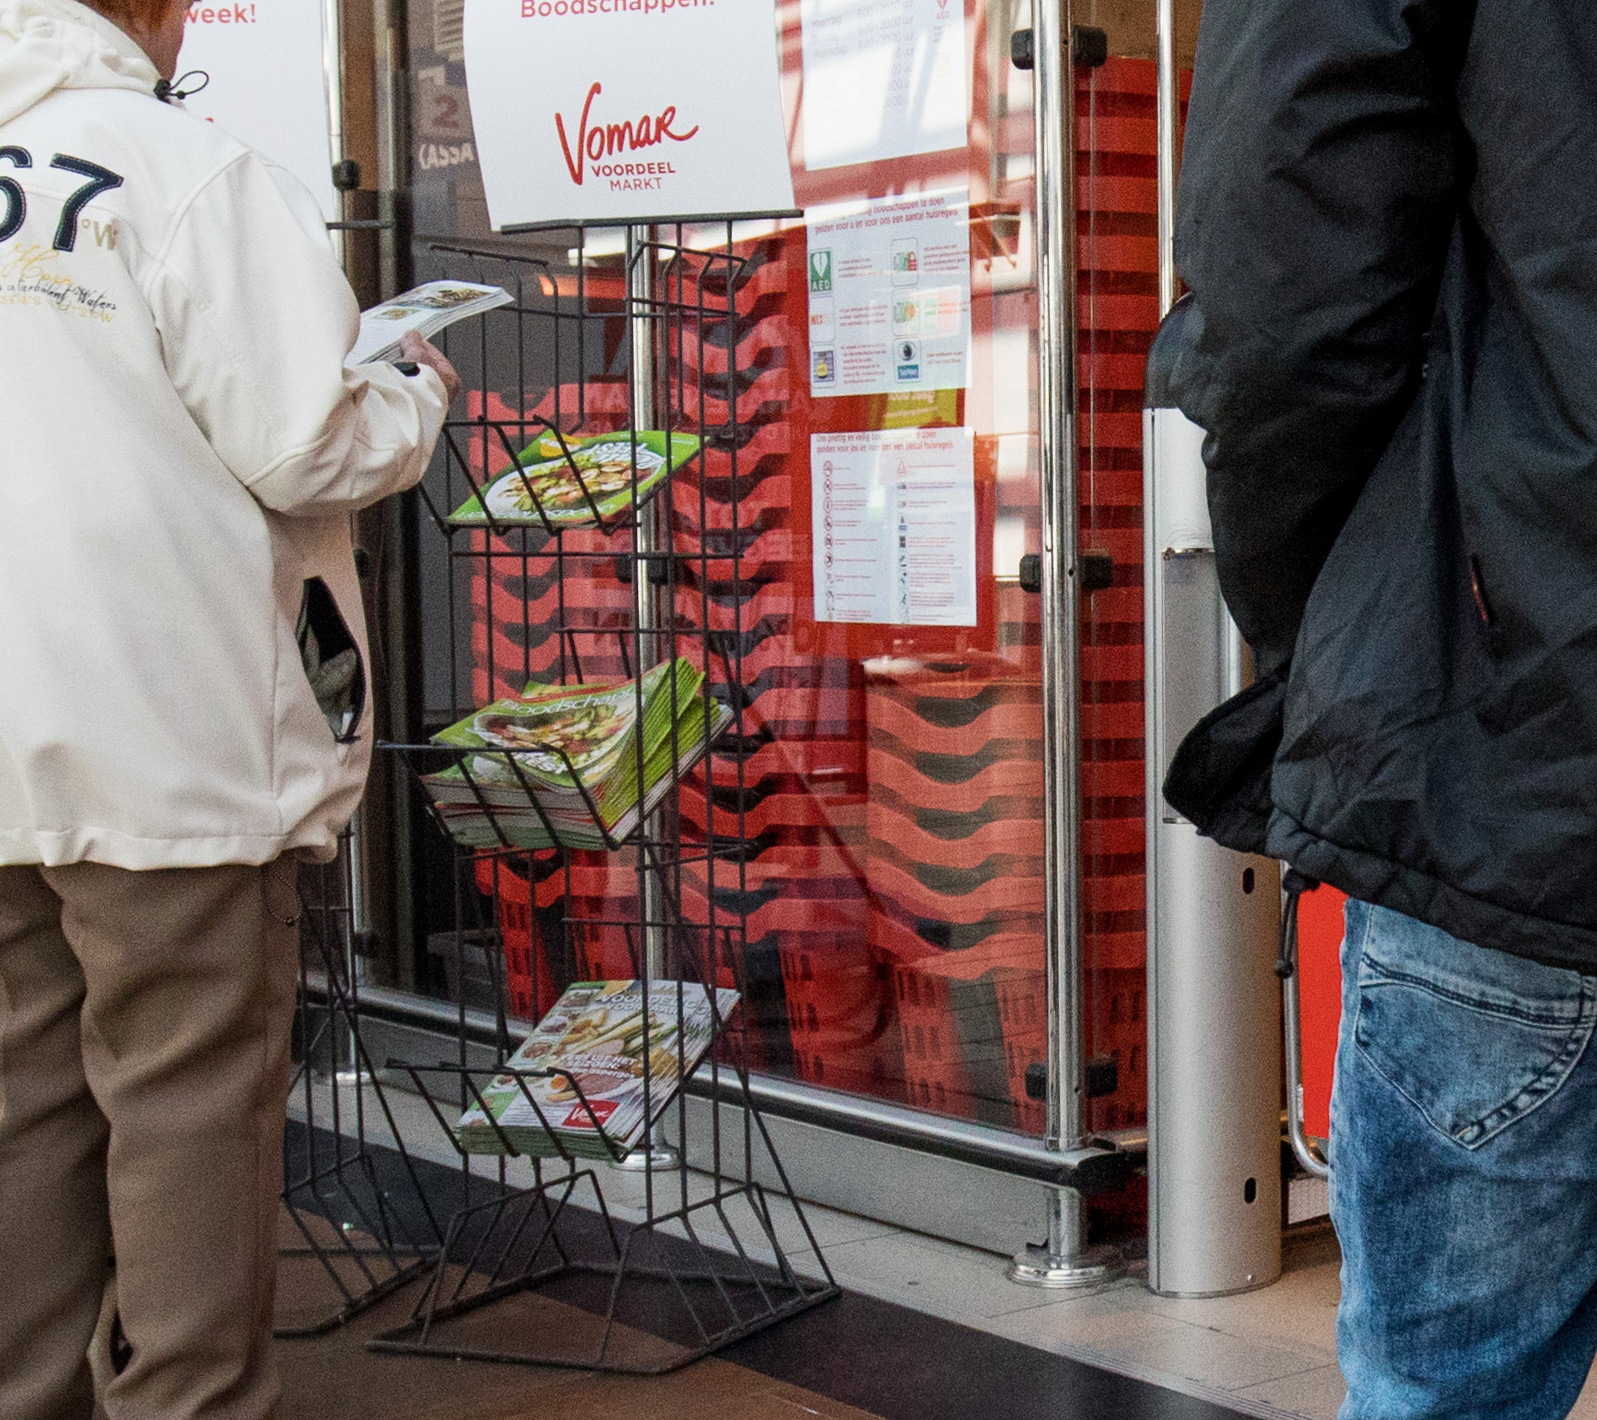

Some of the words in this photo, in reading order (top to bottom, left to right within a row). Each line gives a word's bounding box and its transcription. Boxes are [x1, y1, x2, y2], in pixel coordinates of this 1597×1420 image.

[555, 82, 699, 185] Vomar
[591, 161, 676, 178] VOORDEEL
[609, 177, 662, 191] MARKT
